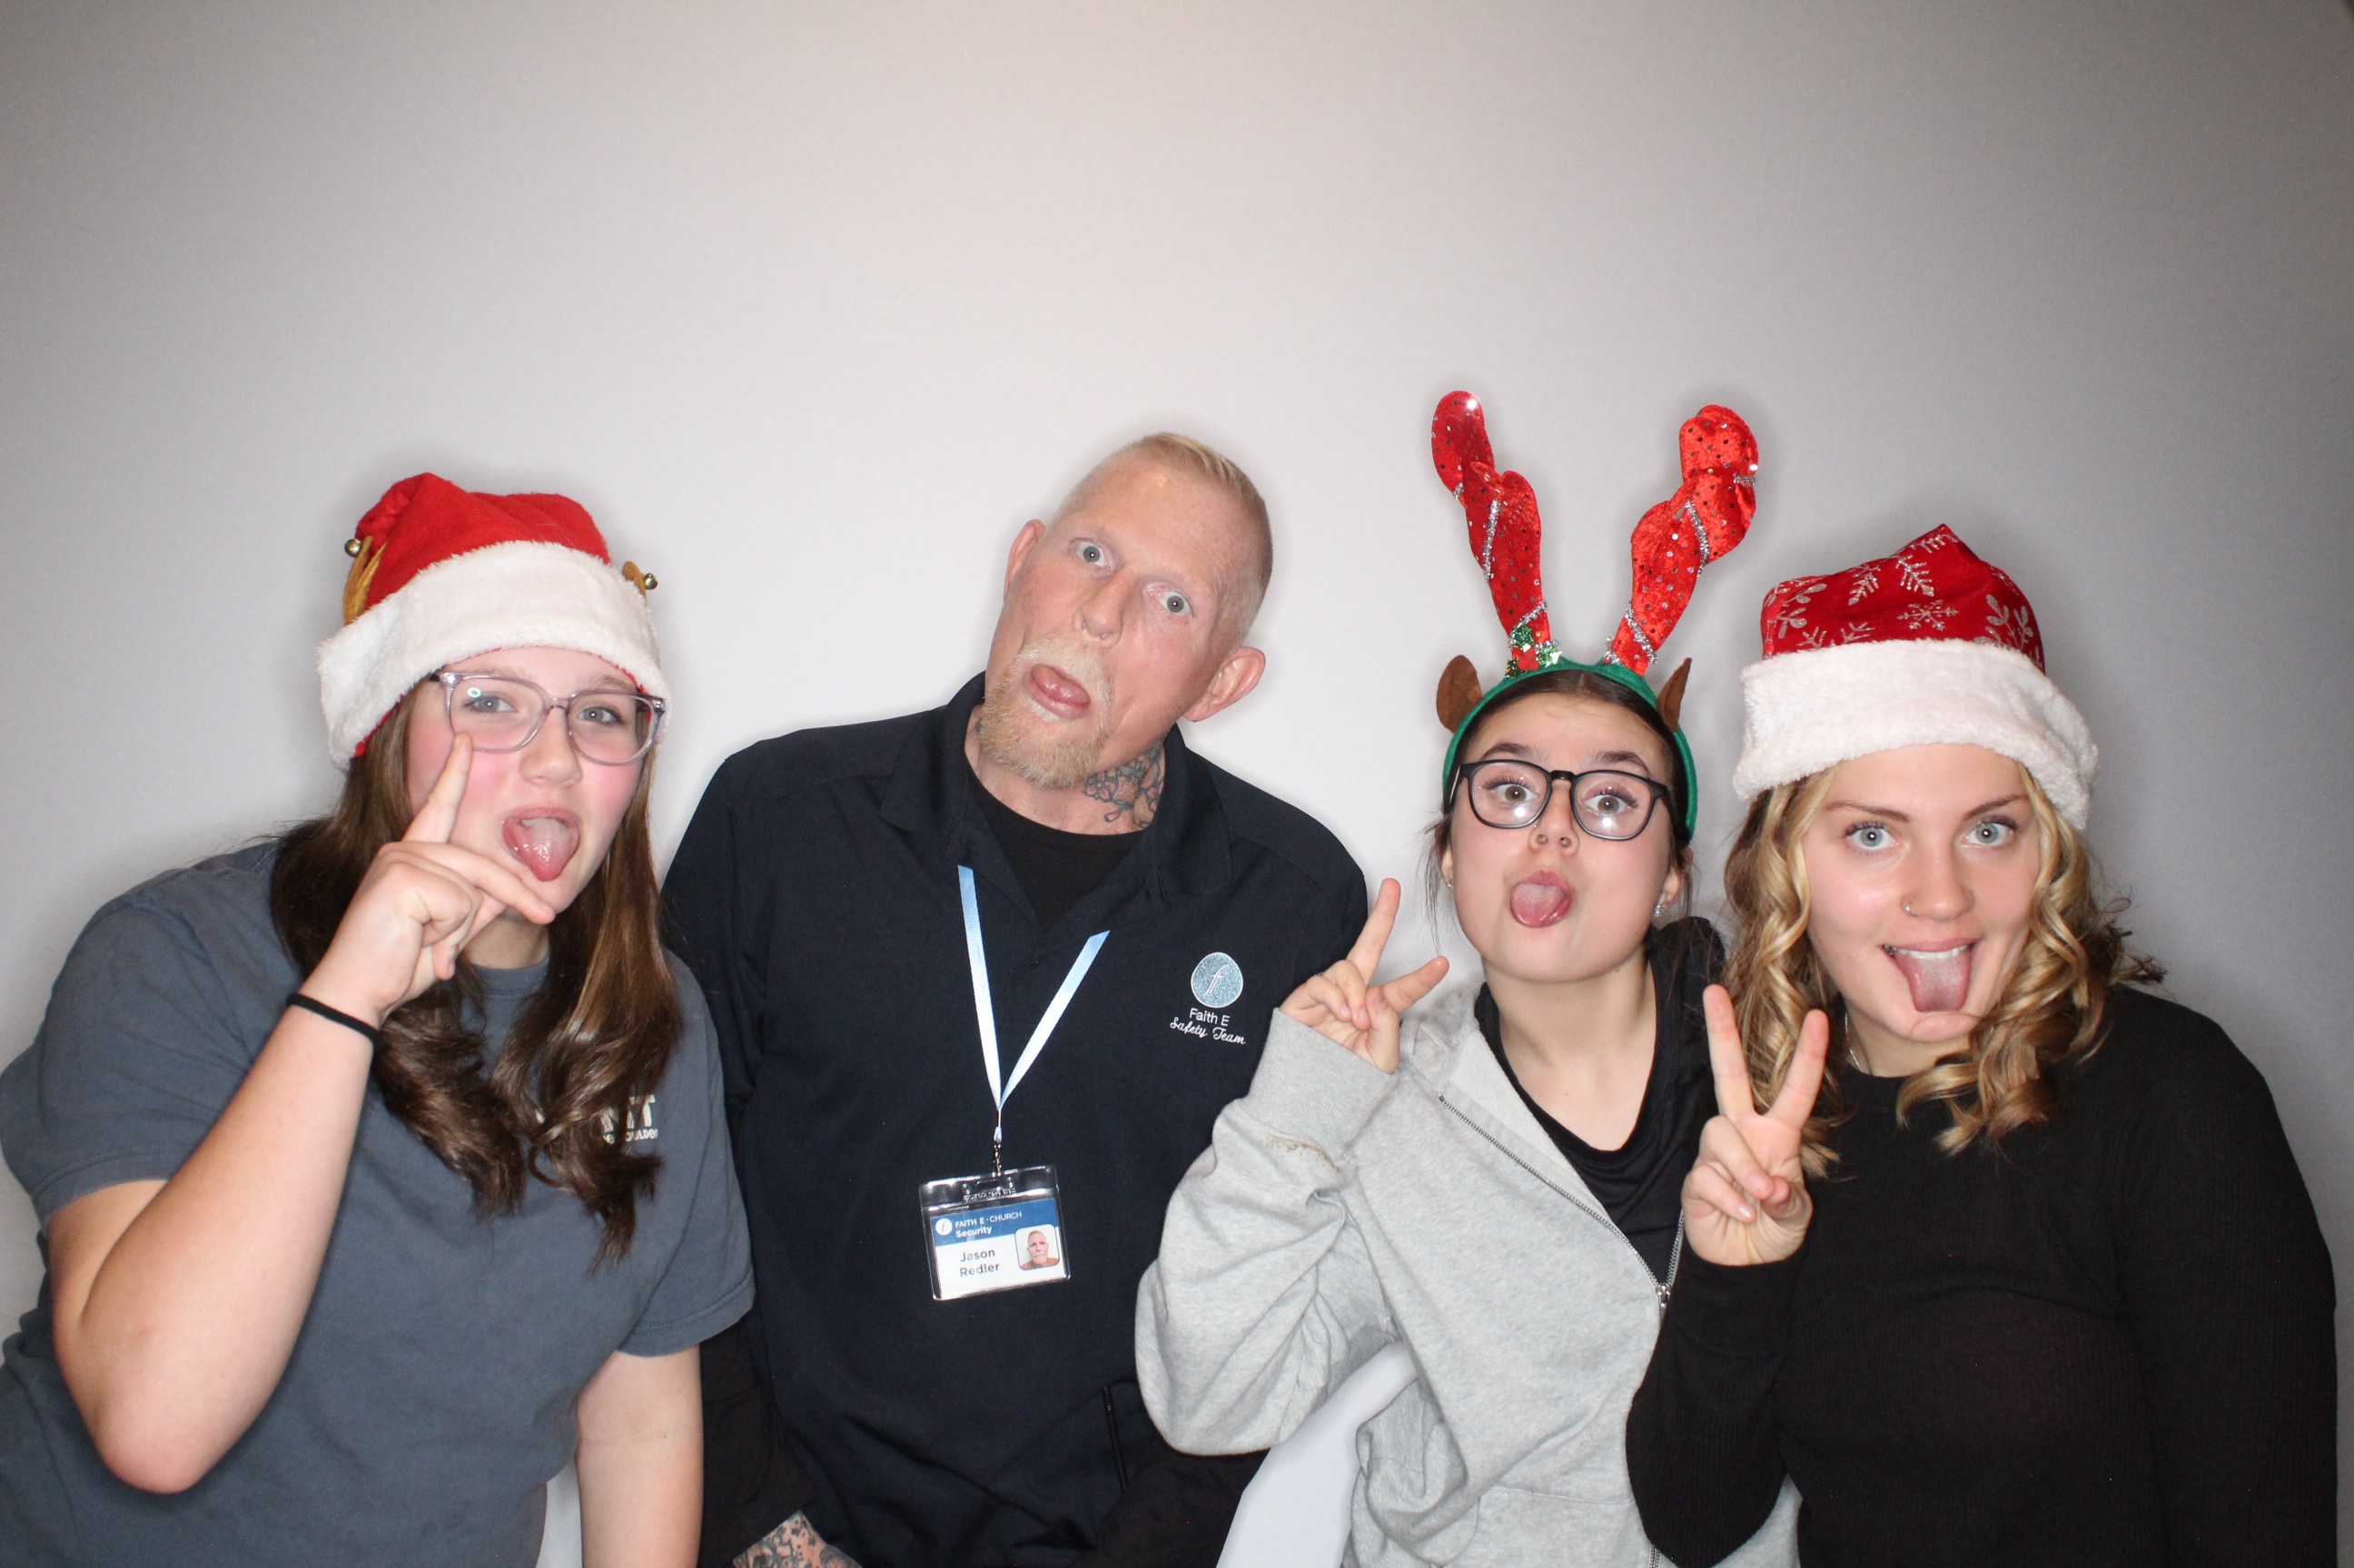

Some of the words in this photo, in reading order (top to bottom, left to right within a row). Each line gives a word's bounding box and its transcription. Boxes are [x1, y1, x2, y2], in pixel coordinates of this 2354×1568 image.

[1189, 1007, 1218, 1024] Faith
[1221, 1014, 1231, 1026] E
[1169, 1016, 1208, 1039] Safety
[1212, 1026, 1246, 1045] Team
[954, 1218, 977, 1228] FAITH
[979, 1217, 985, 1225] E
[989, 1211, 1023, 1223] CHURCH
[955, 1226, 992, 1238] Security
[960, 1248, 995, 1262] Jason
[959, 1263, 1000, 1277] Redler
